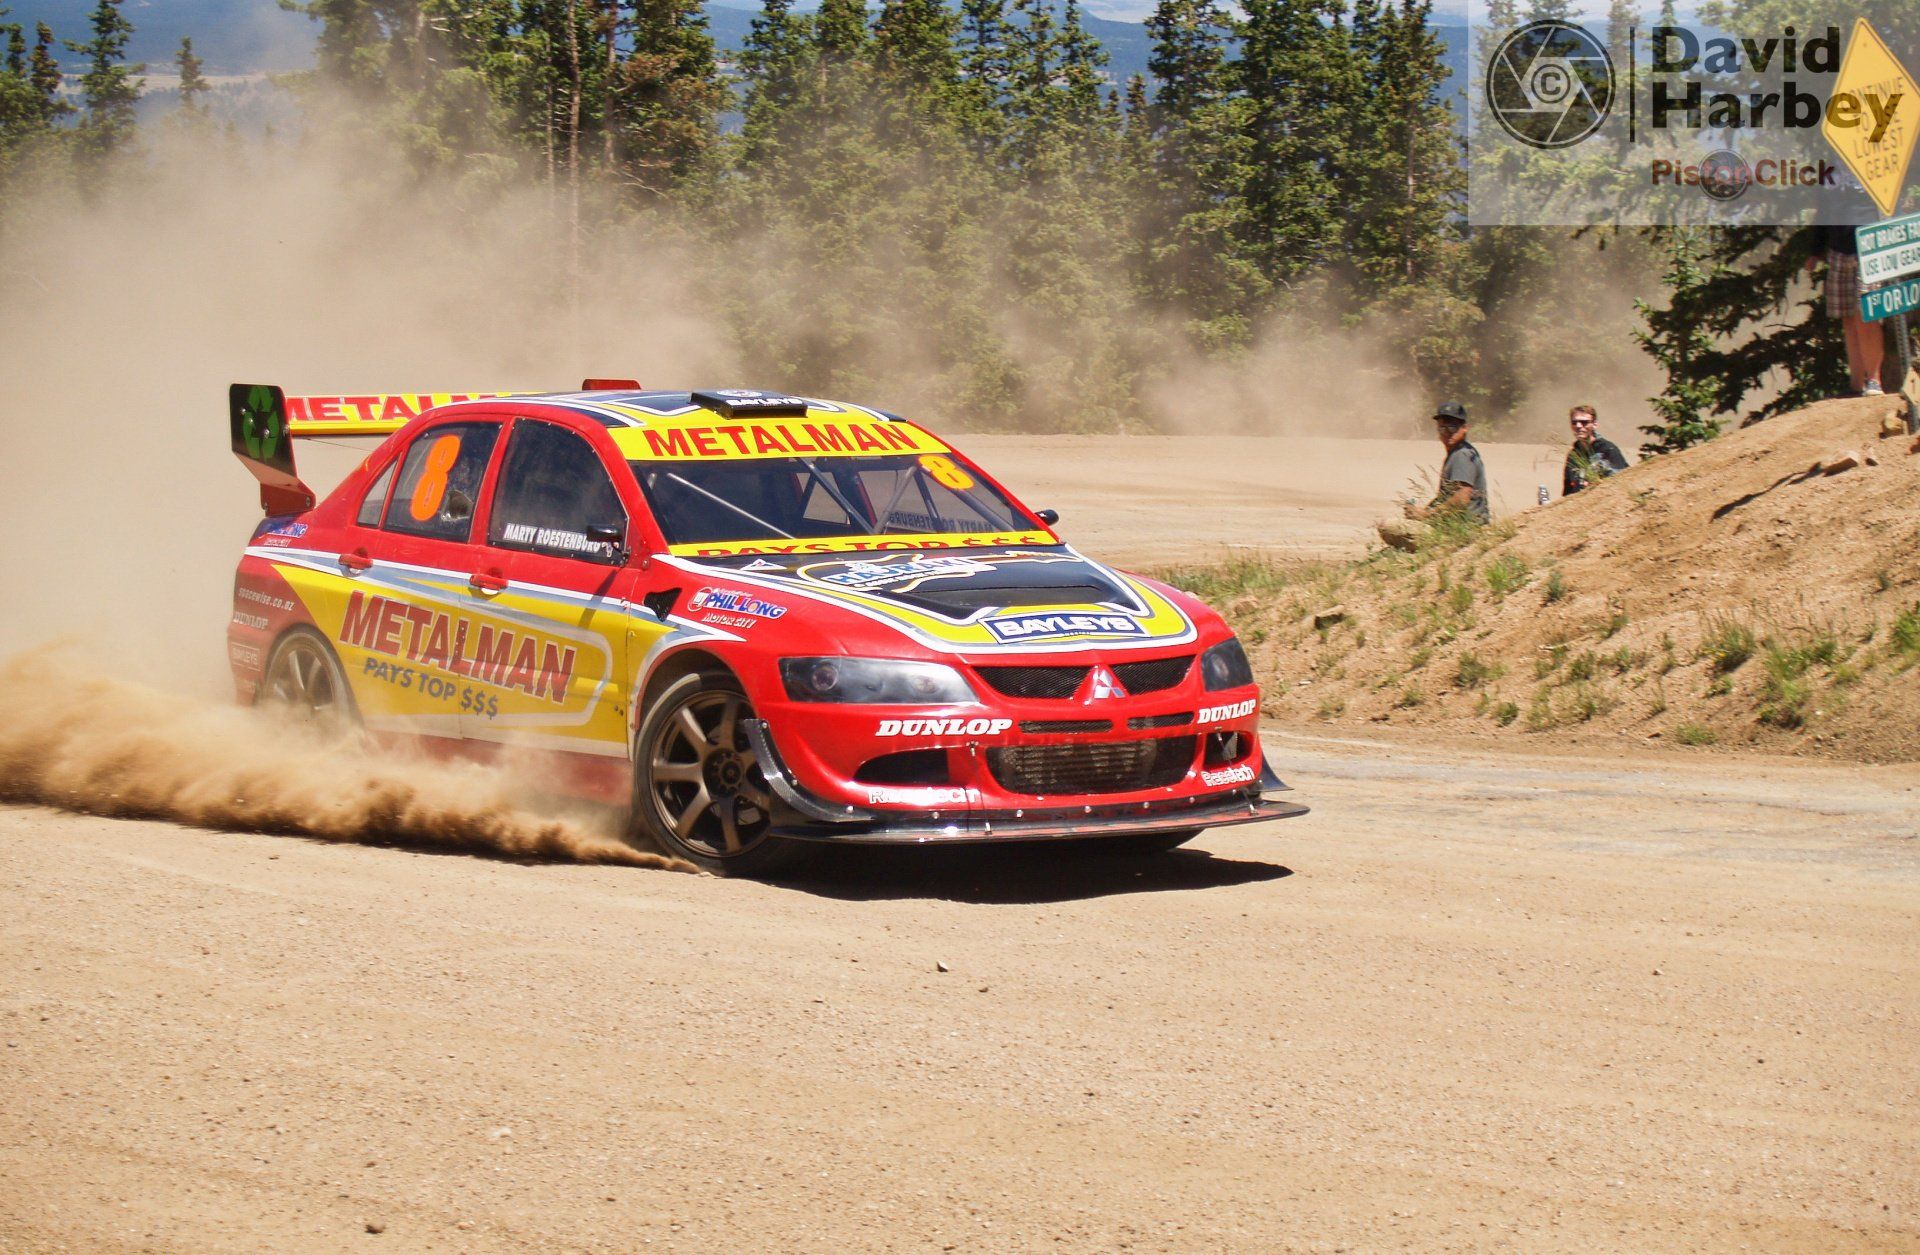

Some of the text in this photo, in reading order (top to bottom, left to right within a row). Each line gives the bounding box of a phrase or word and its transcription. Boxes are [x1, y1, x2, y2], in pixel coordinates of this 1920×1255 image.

[1852, 127, 1904, 158] LOWEST
[1866, 154, 1899, 181] GEAR
[1864, 258, 1880, 276] USE
[1881, 252, 1899, 272] LOW
[1883, 288, 1903, 312] OR
[1903, 283, 1920, 306] LO
[643, 424, 920, 456] METALMAN
[410, 434, 461, 521] 8
[918, 454, 975, 489] 8
[503, 522, 538, 542] MARTY
[704, 591, 736, 611] PHIL
[737, 595, 787, 619] LONG
[233, 611, 268, 630] DUNLOP
[701, 612, 757, 629] MOTOR CITY
[993, 616, 1136, 637] BAYLEYS
[339, 589, 577, 704] METALMAN
[364, 656, 499, 721] PAYS TOP $$$
[1197, 699, 1256, 724] DUNLOP
[875, 718, 1013, 737] DUNLOP
[1200, 764, 1256, 787] Racetech
